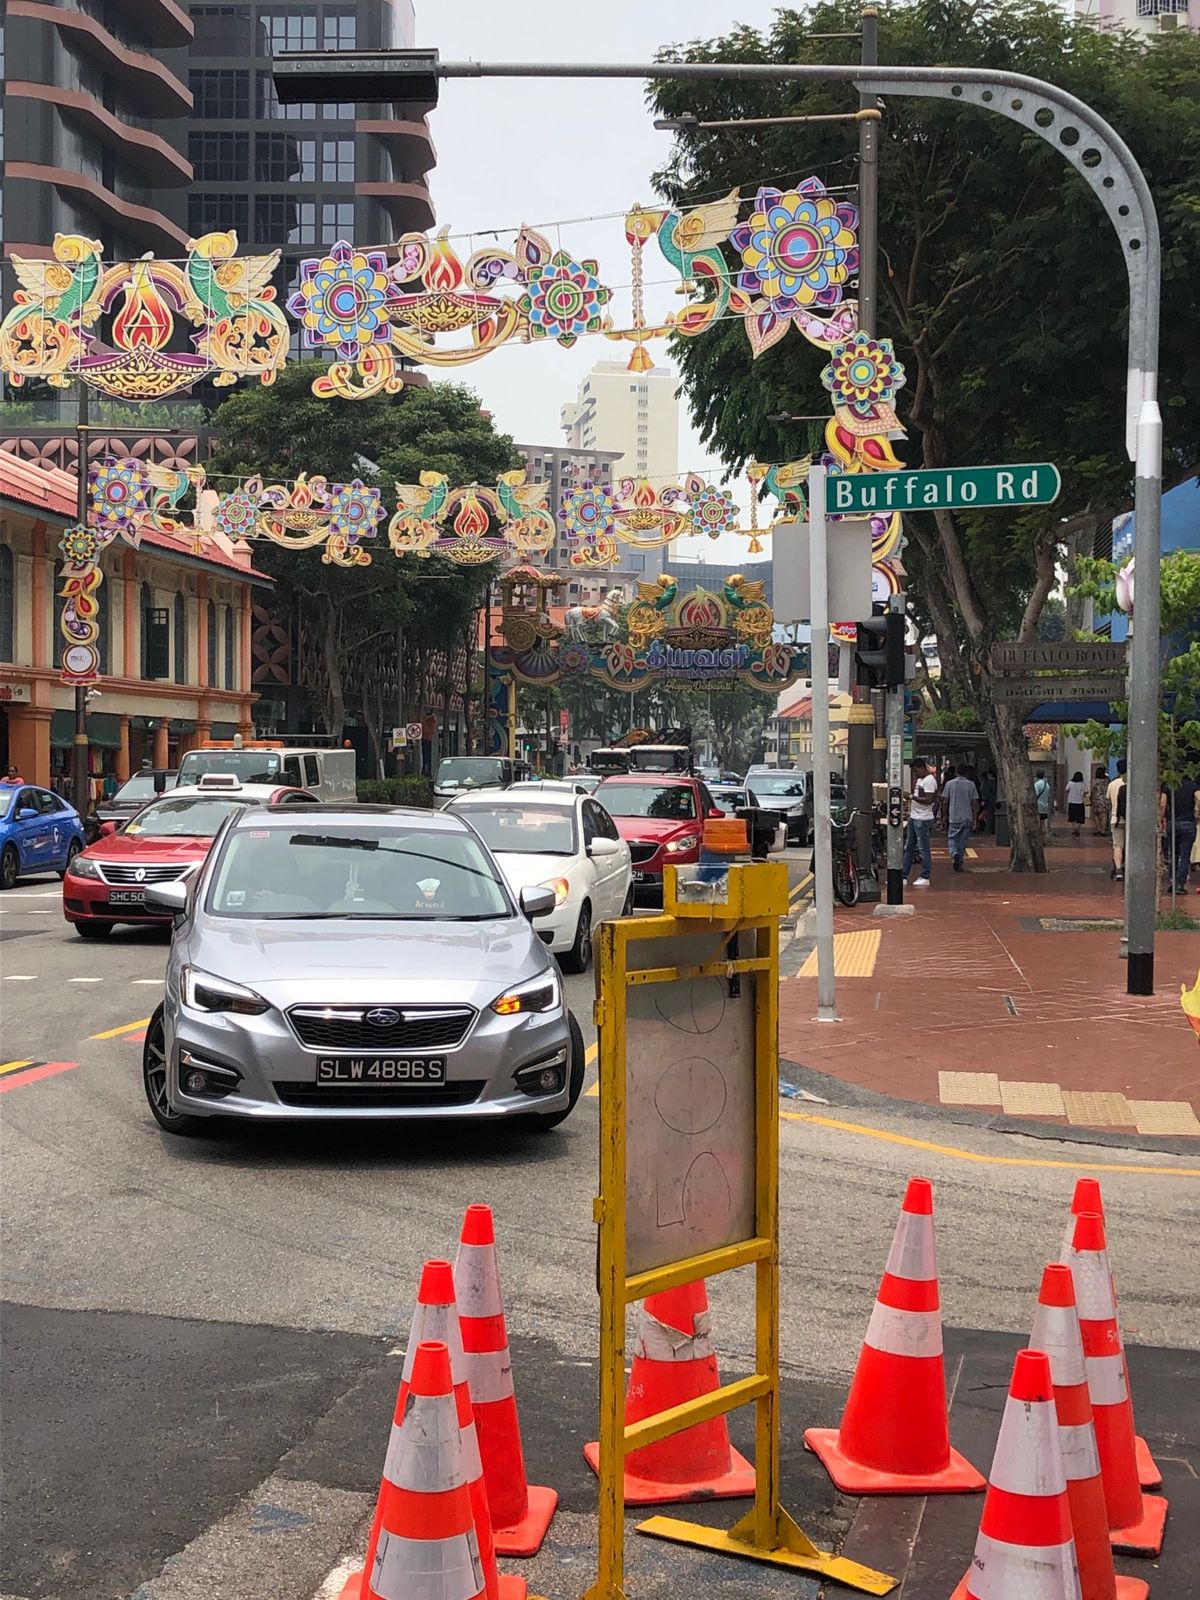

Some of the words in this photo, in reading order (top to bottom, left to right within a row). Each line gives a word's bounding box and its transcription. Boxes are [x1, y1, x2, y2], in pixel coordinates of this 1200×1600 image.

[836, 475, 978, 508] Buffalo
[996, 470, 1038, 500] Rd
[1075, 649, 1117, 663] ROAD
[110, 891, 145, 902] SHC50
[320, 1060, 442, 1079] SLW4896S
